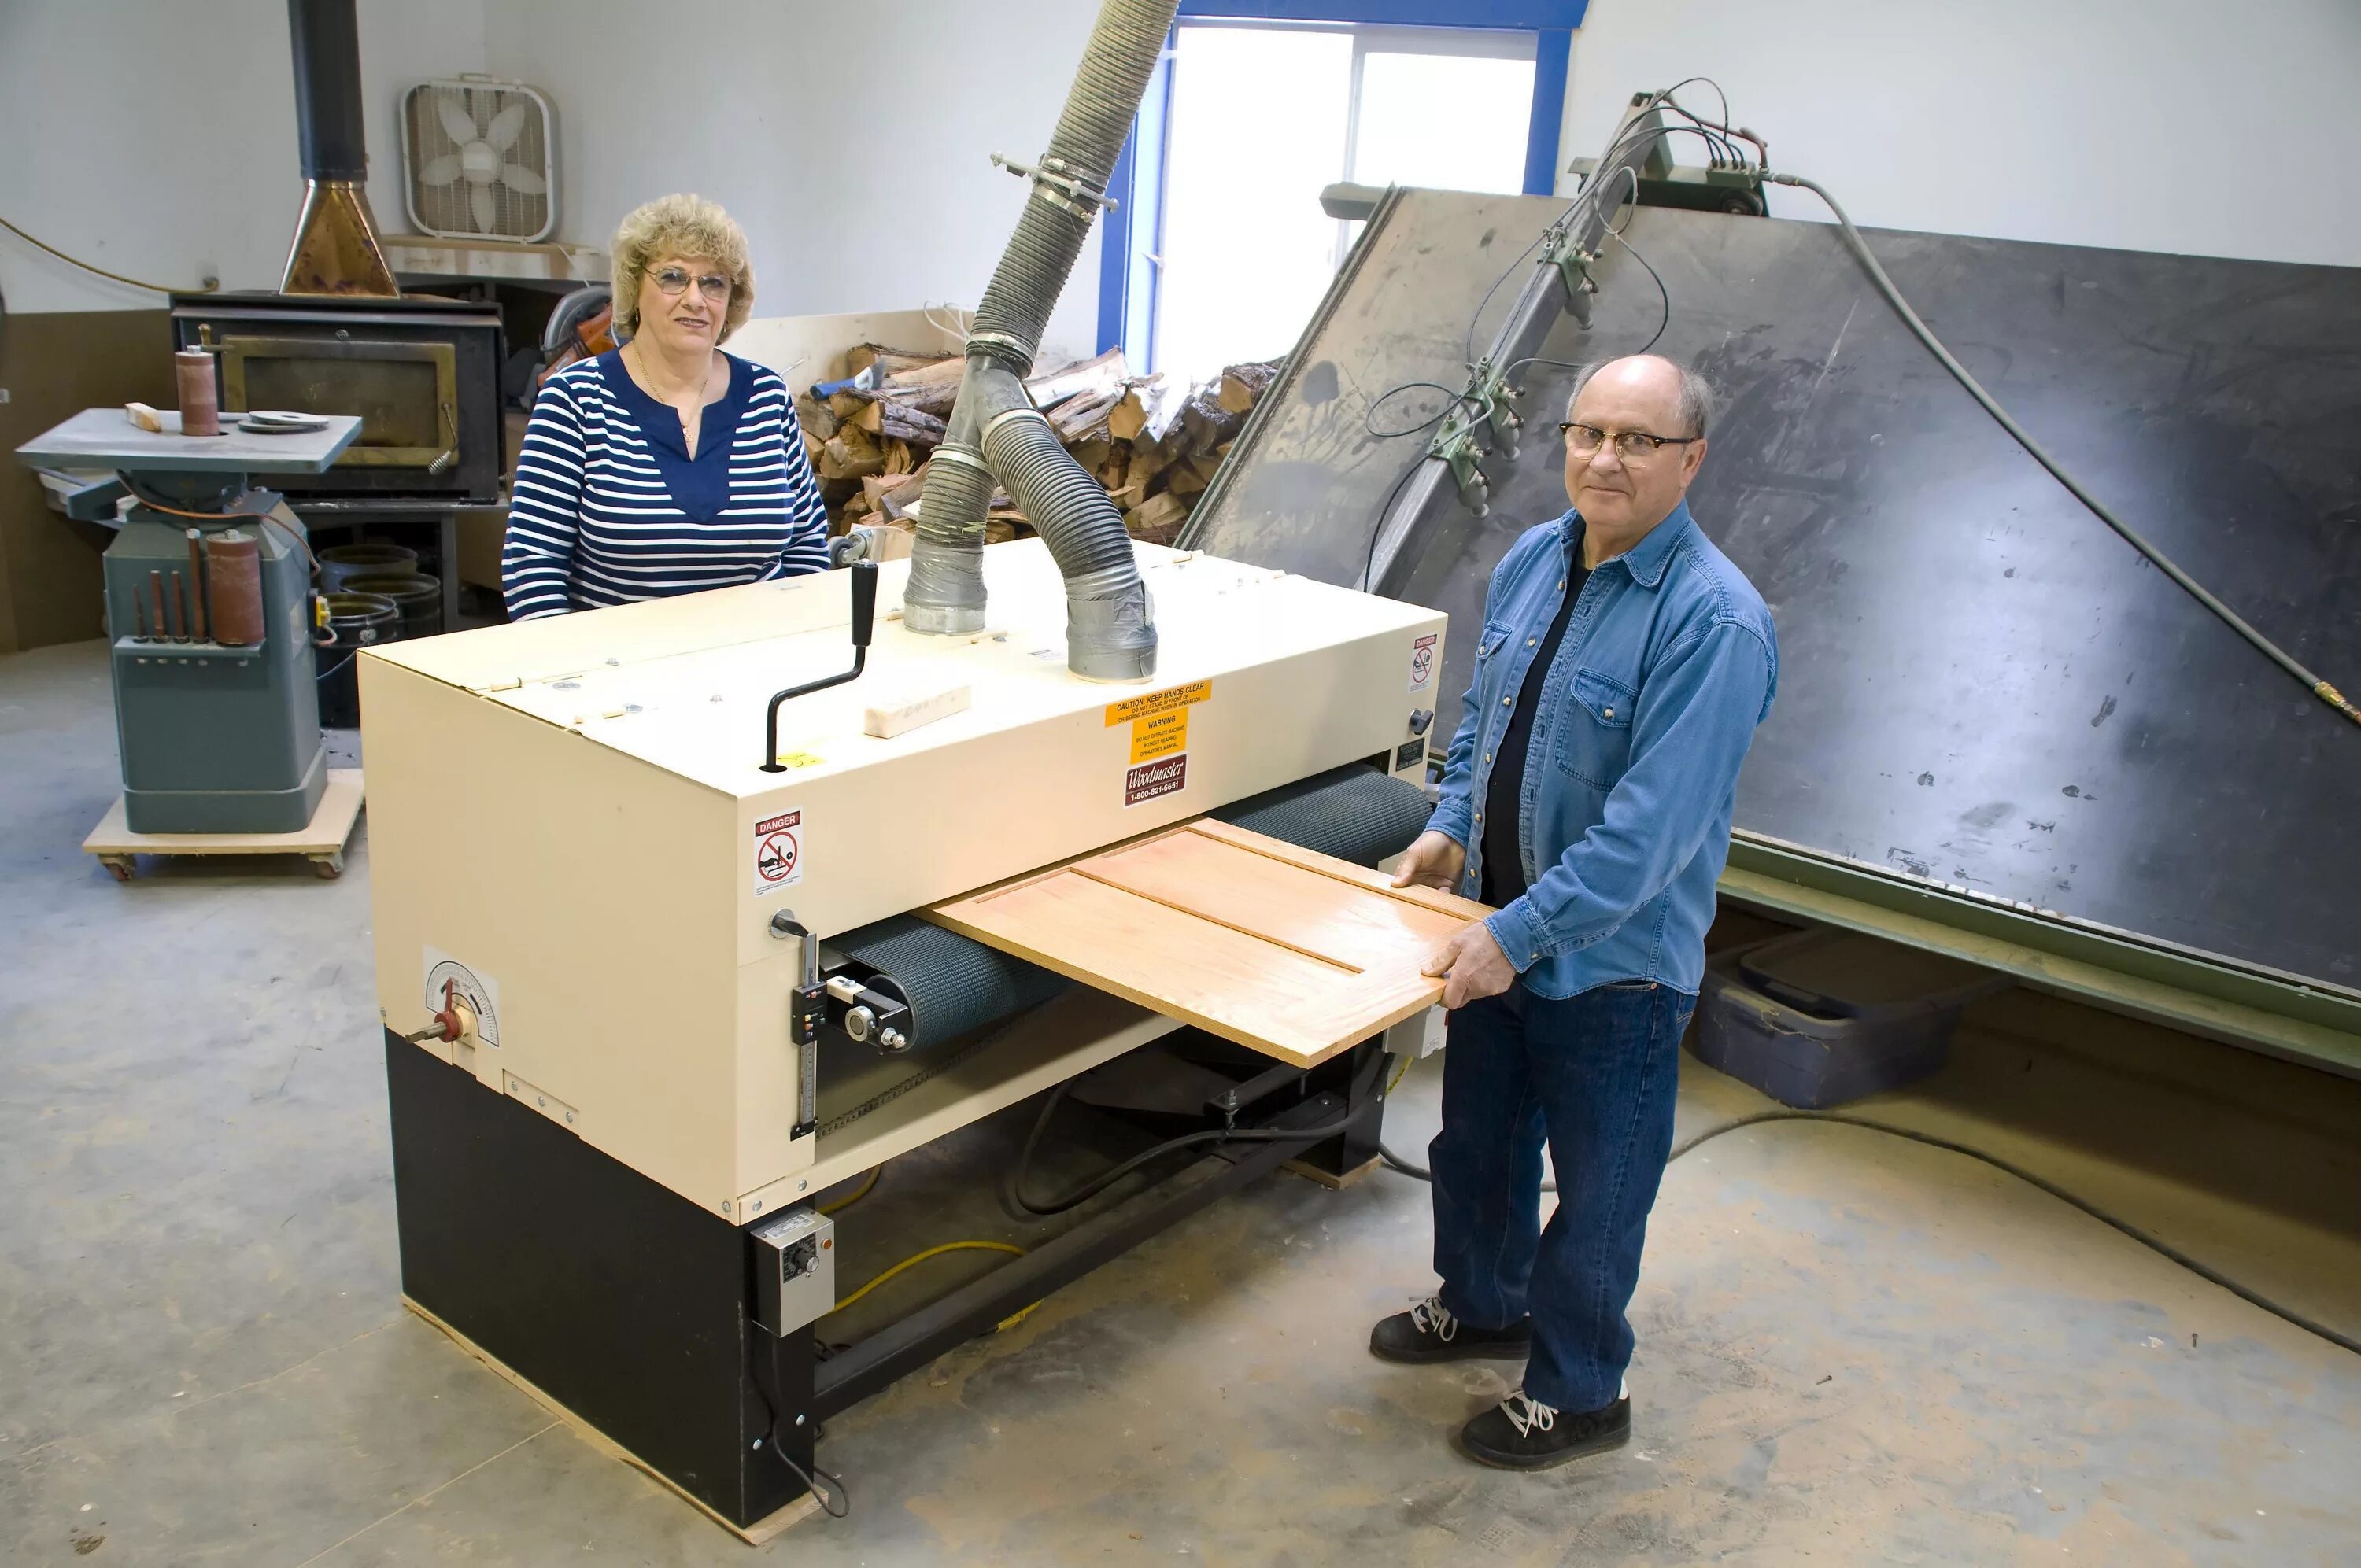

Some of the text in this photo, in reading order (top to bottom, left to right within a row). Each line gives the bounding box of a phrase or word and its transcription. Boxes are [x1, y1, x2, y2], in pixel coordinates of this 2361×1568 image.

[1147, 693, 1162, 703] KEEP
[1164, 688, 1184, 699] HANDS
[1185, 682, 1204, 694] CLEAR
[1149, 701, 1163, 710] STAND
[1169, 695, 1183, 704] FRONT
[1125, 713, 1141, 721] BEHIND
[1147, 715, 1176, 729] WARNING
[1168, 725, 1184, 734] MACHINE
[1143, 735, 1177, 748] WITHOUT READING
[1163, 742, 1178, 751] MANUAL
[1129, 762, 1184, 790] Woodmaster
[1131, 780, 1179, 802] 1-800-821-6651
[759, 815, 796, 833] DANGER
